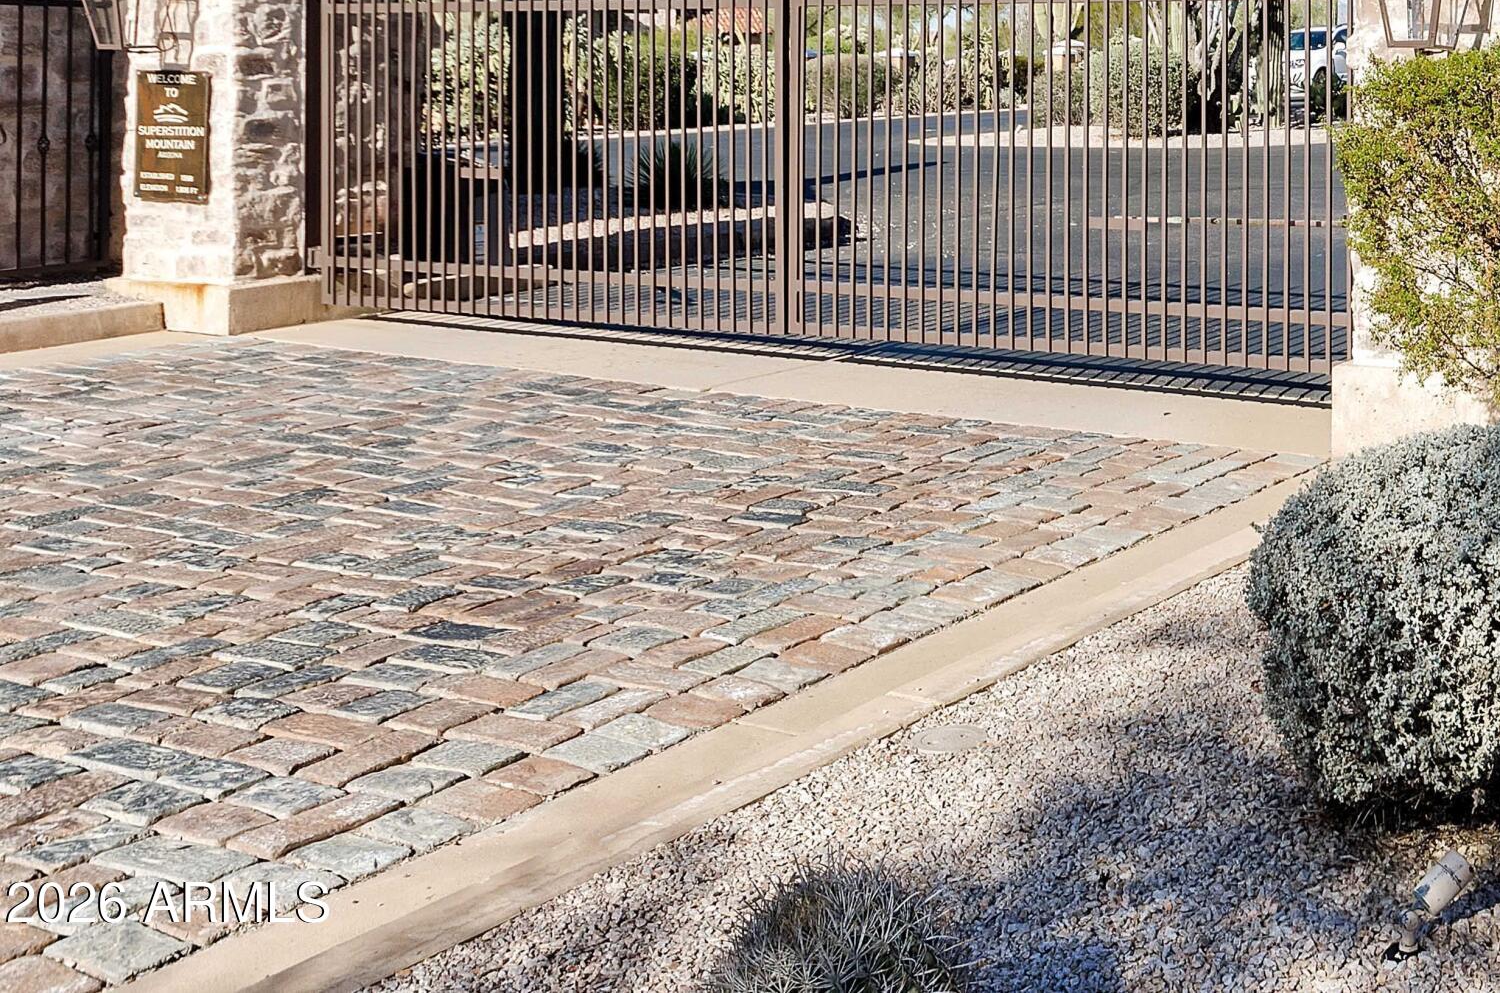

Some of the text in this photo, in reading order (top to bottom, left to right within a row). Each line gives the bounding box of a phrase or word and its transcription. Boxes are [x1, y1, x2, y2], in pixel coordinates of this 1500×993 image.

[147, 73, 197, 85] WELCOME
[164, 87, 179, 98] TO
[138, 125, 205, 137] SUPERSTITION
[145, 139, 196, 150] MOUNTAIN
